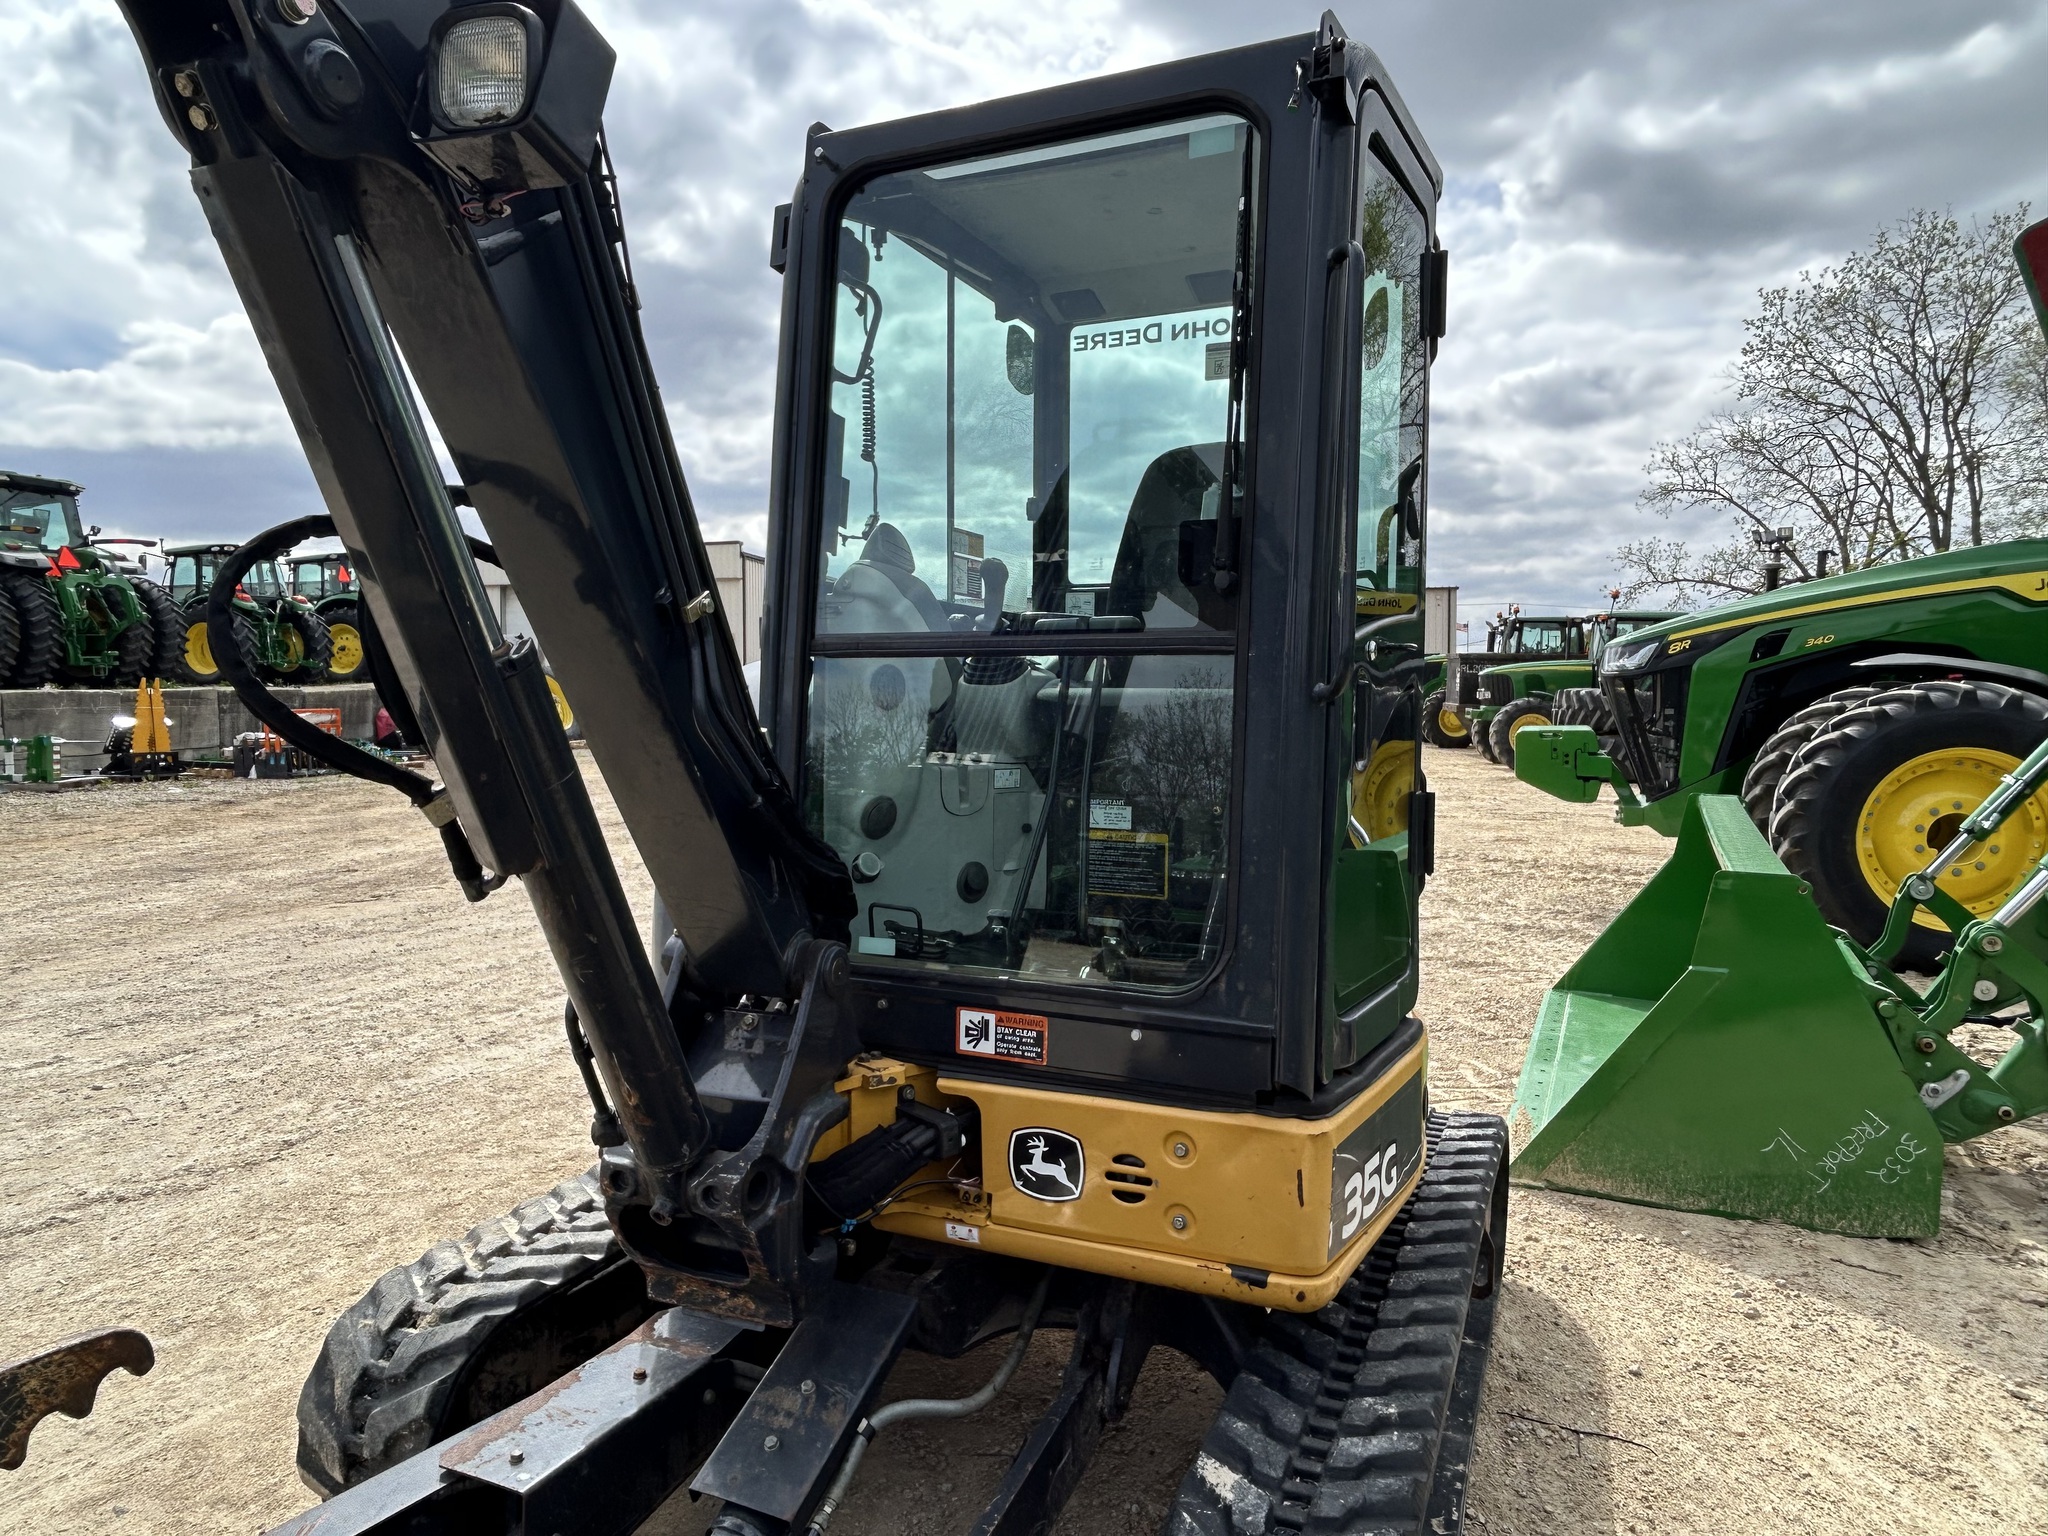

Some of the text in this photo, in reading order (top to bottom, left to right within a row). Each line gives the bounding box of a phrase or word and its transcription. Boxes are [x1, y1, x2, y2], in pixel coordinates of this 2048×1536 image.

[1667, 639, 1692, 654] 8R
[1804, 634, 1836, 648] 340
[1005, 1016, 1044, 1028] WARNING
[997, 1026, 1037, 1038] STAY CLEAR
[1806, 1109, 1890, 1194] FREEPORT
[1341, 1142, 1397, 1240] 35G
